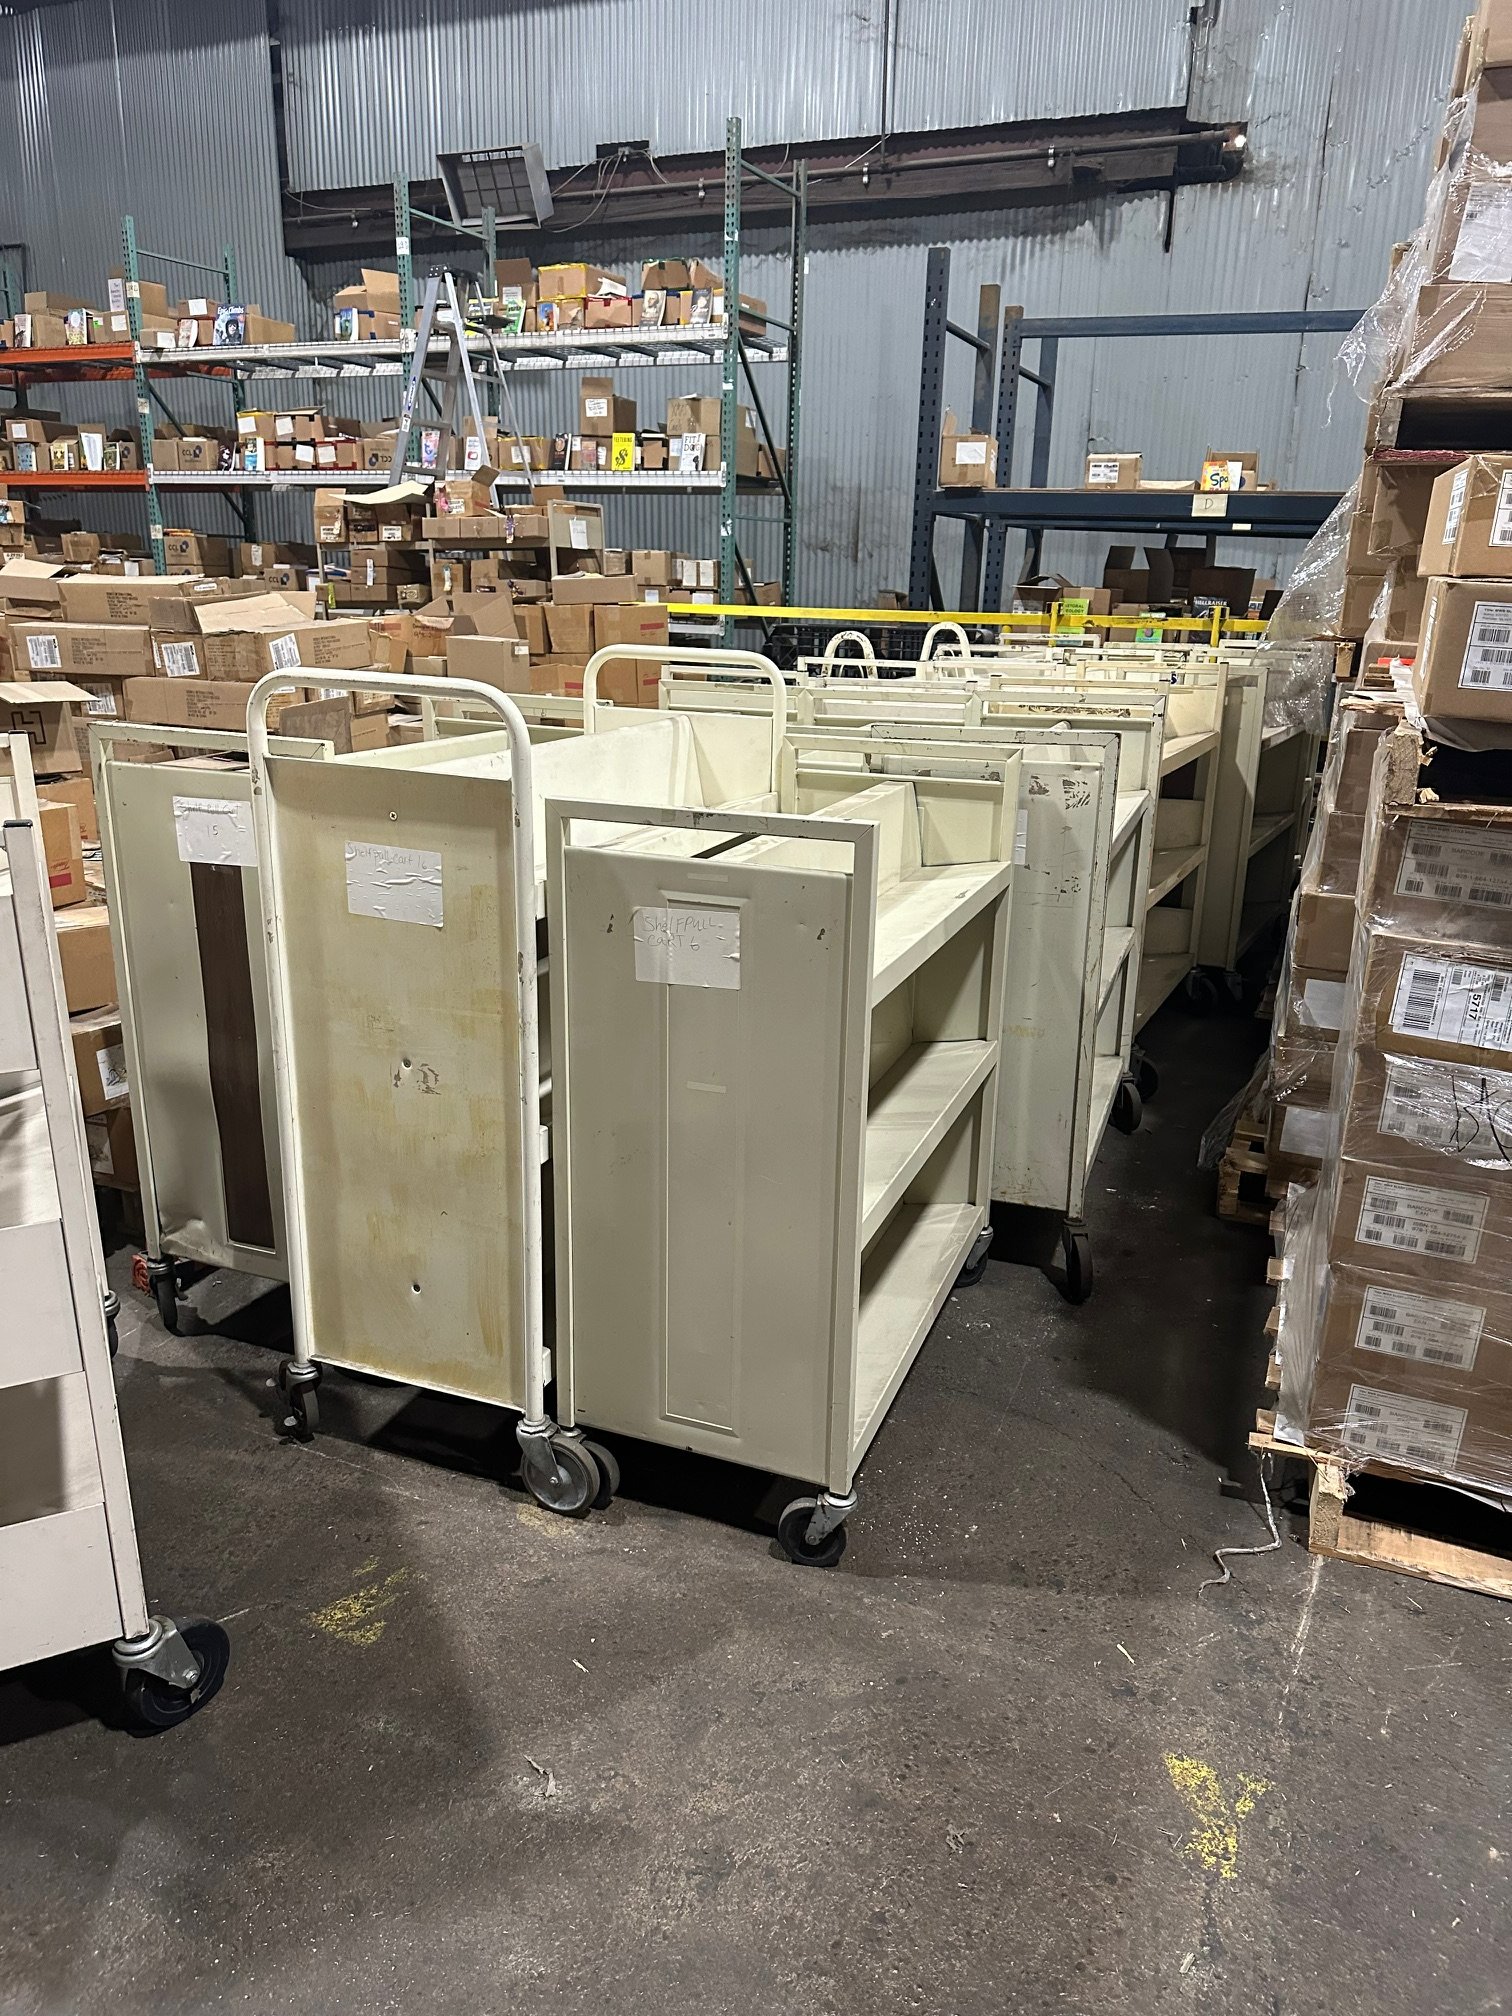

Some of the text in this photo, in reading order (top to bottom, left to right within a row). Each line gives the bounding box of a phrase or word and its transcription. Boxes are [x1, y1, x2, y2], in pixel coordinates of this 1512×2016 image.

[1204, 497, 1214, 510] D
[168, 543, 179, 551] CCL
[690, 936, 700, 951] 6
[1468, 993, 1482, 1021] 5717
[1406, 1203, 1439, 1214] BARCODE
[1415, 1209, 1429, 1217] EAN
